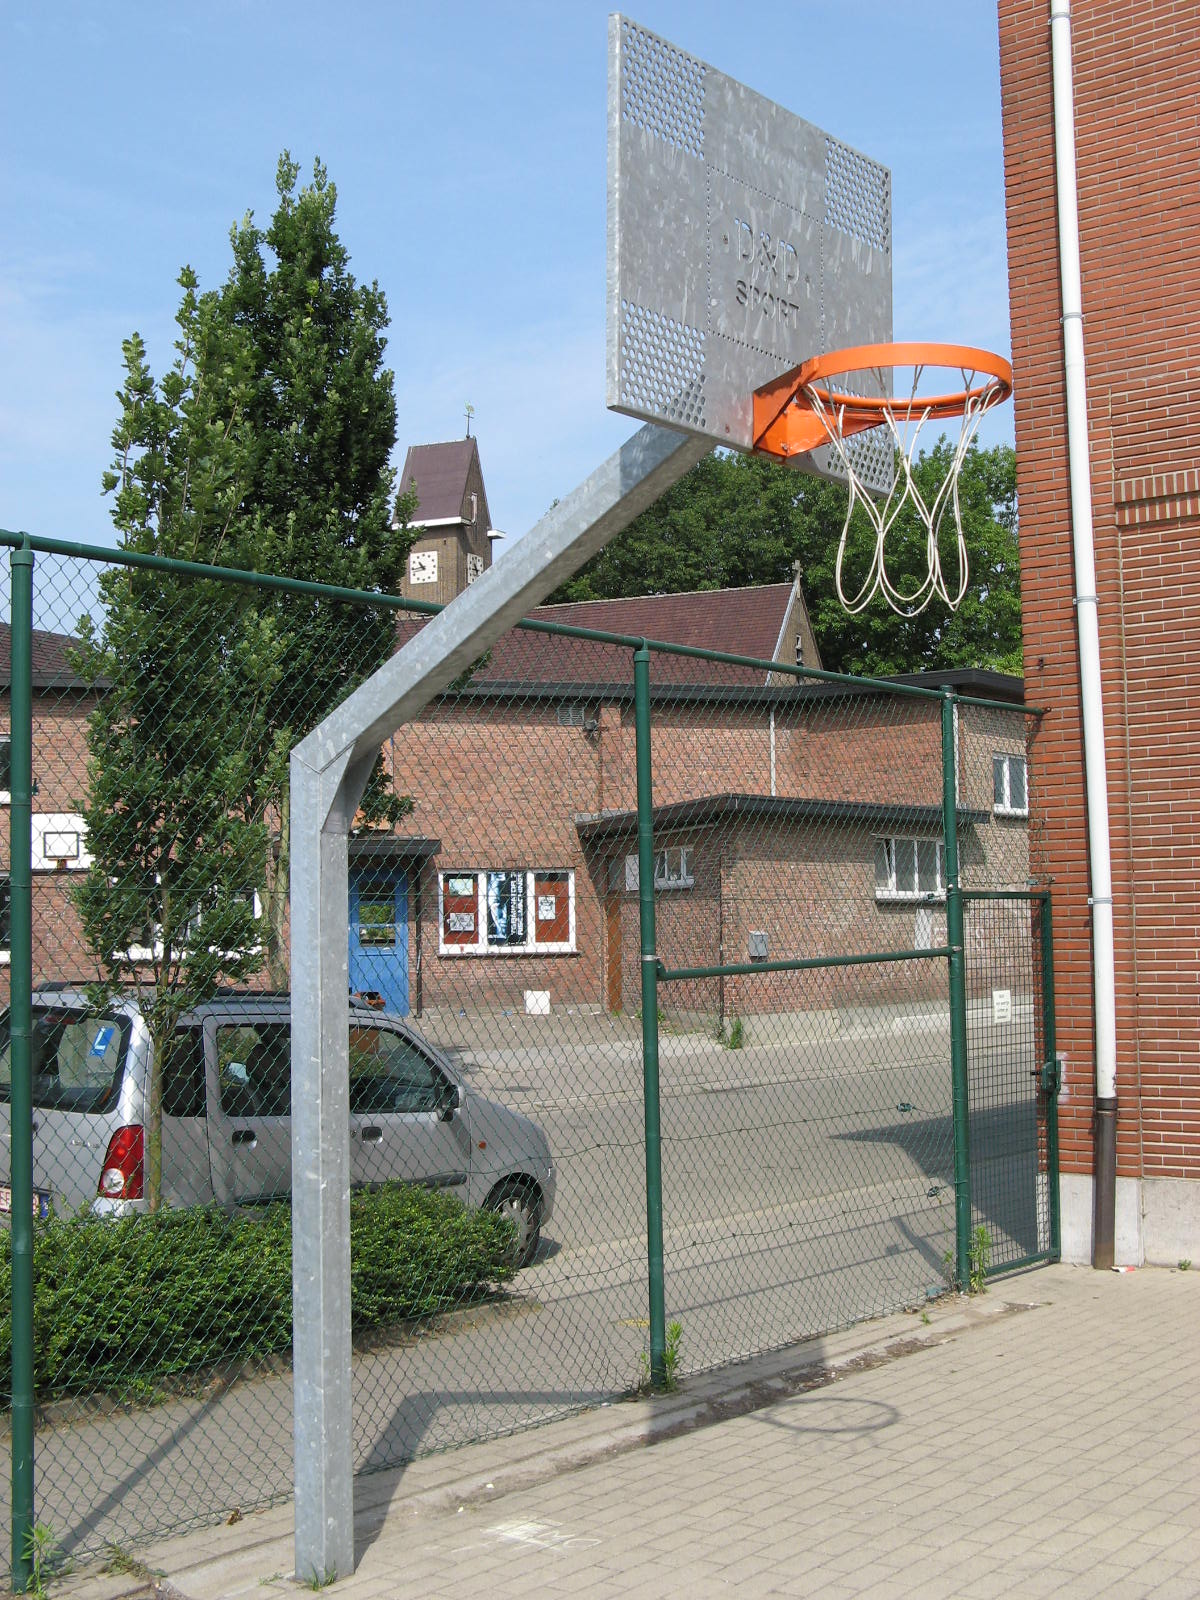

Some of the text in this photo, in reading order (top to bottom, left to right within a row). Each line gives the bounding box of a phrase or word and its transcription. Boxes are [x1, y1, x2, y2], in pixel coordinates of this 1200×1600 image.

[735, 217, 800, 284] D&D
[735, 279, 800, 329] SPORT
[94, 1026, 106, 1051] L
